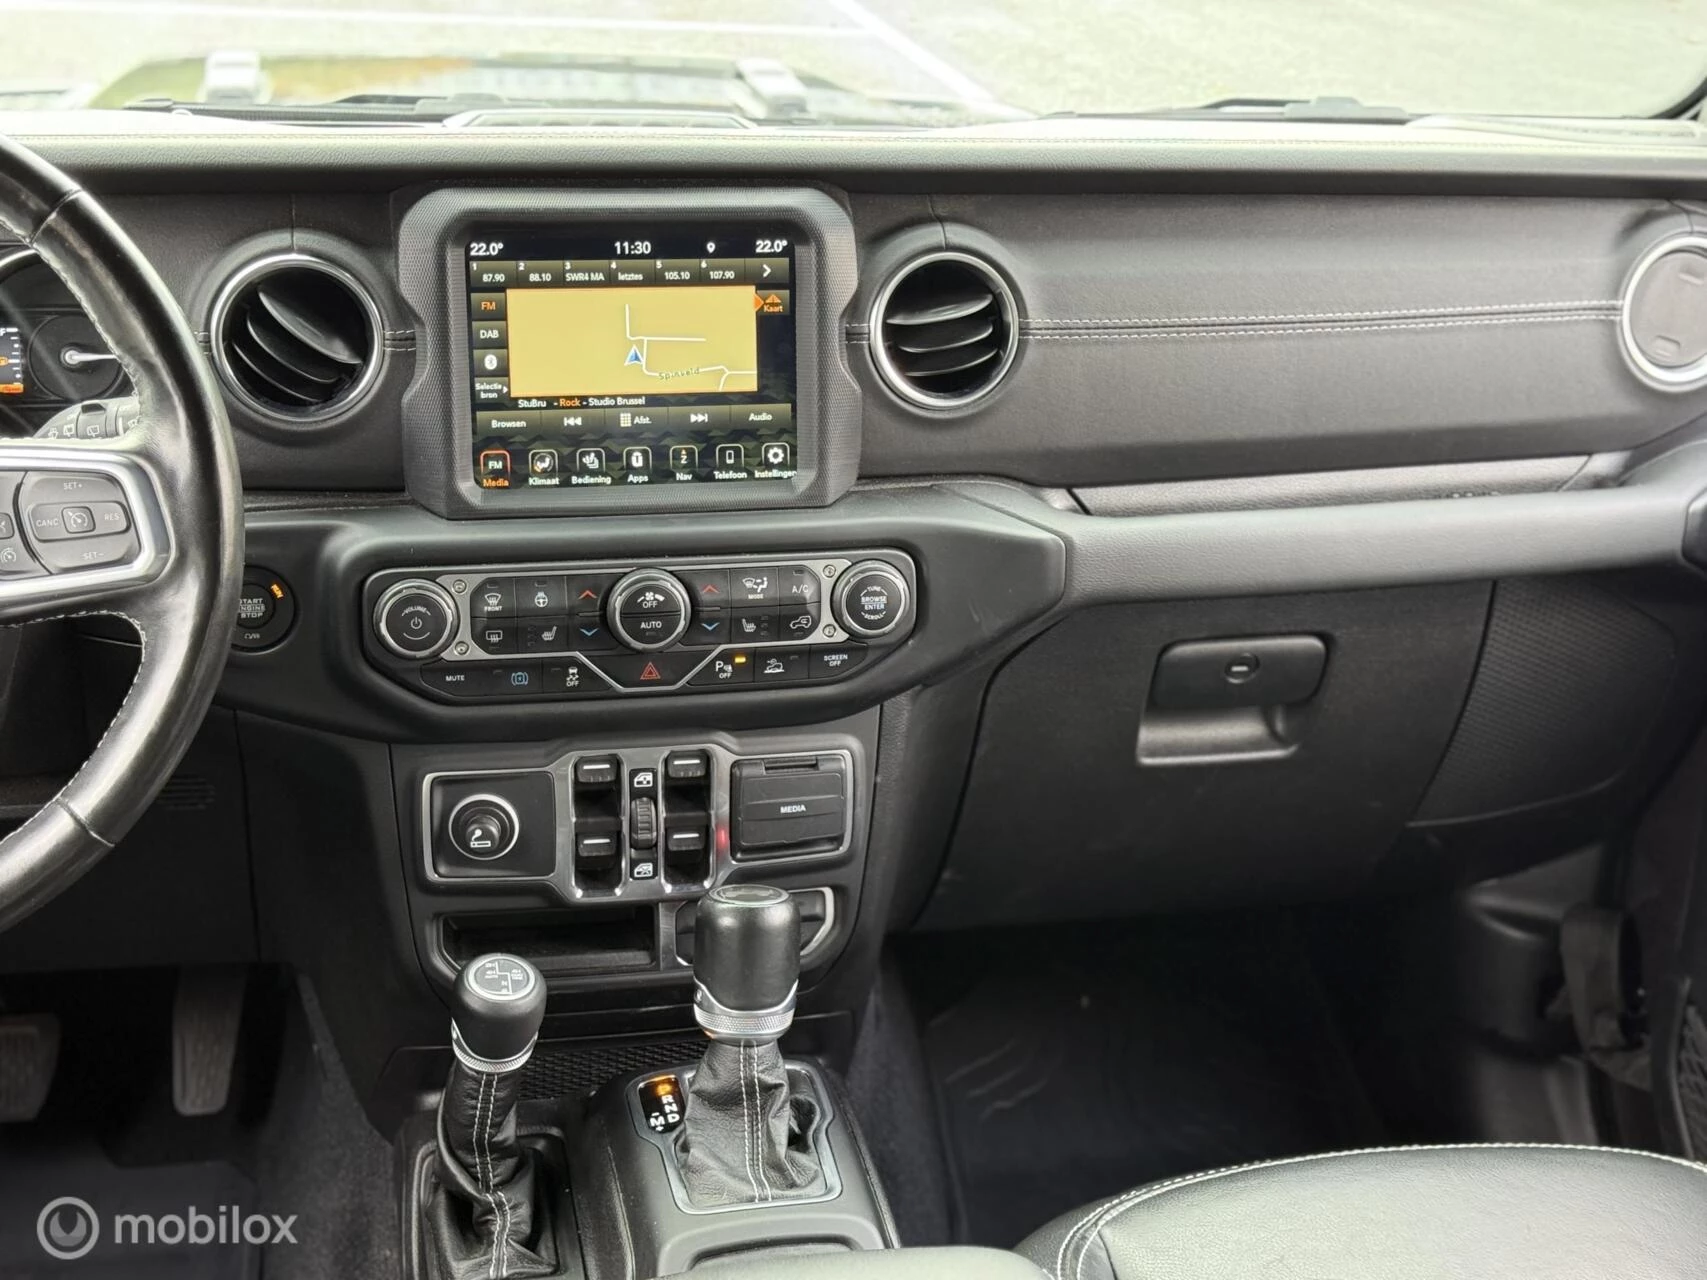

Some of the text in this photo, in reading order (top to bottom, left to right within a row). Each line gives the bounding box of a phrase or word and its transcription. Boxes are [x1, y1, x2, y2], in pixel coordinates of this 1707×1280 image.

[614, 241, 651, 254] 11:30
[518, 262, 524, 270] 2
[482, 274, 505, 282] 87.90
[529, 273, 552, 282] 88.10
[566, 272, 605, 281] SWR4 MA
[618, 272, 643, 281] letztes
[664, 272, 690, 280] 105.10
[709, 271, 735, 280] 107.90
[481, 302, 496, 311] FM
[764, 305, 783, 313] Kaart
[480, 330, 499, 338] DAB
[559, 398, 580, 407] Rock
[588, 398, 615, 406] Studio
[617, 396, 645, 406] Brussel
[749, 413, 772, 421] Audio
[491, 420, 526, 428] Browsen
[488, 461, 503, 469] FM
[571, 475, 612, 485] Bediening
[627, 474, 648, 483] Apps
[676, 472, 692, 481] Nav
[714, 471, 748, 480] Telefoon
[483, 478, 509, 487] Media
[529, 477, 559, 485] Klimaat
[36, 518, 59, 527] CANC
[792, 584, 809, 593] A/C
[715, 661, 724, 672] P
[781, 804, 806, 813] MEDIA
[661, 1094, 674, 1104] R
[664, 1103, 678, 1114] N
[650, 1115, 665, 1126] M
[667, 1113, 680, 1123] D
